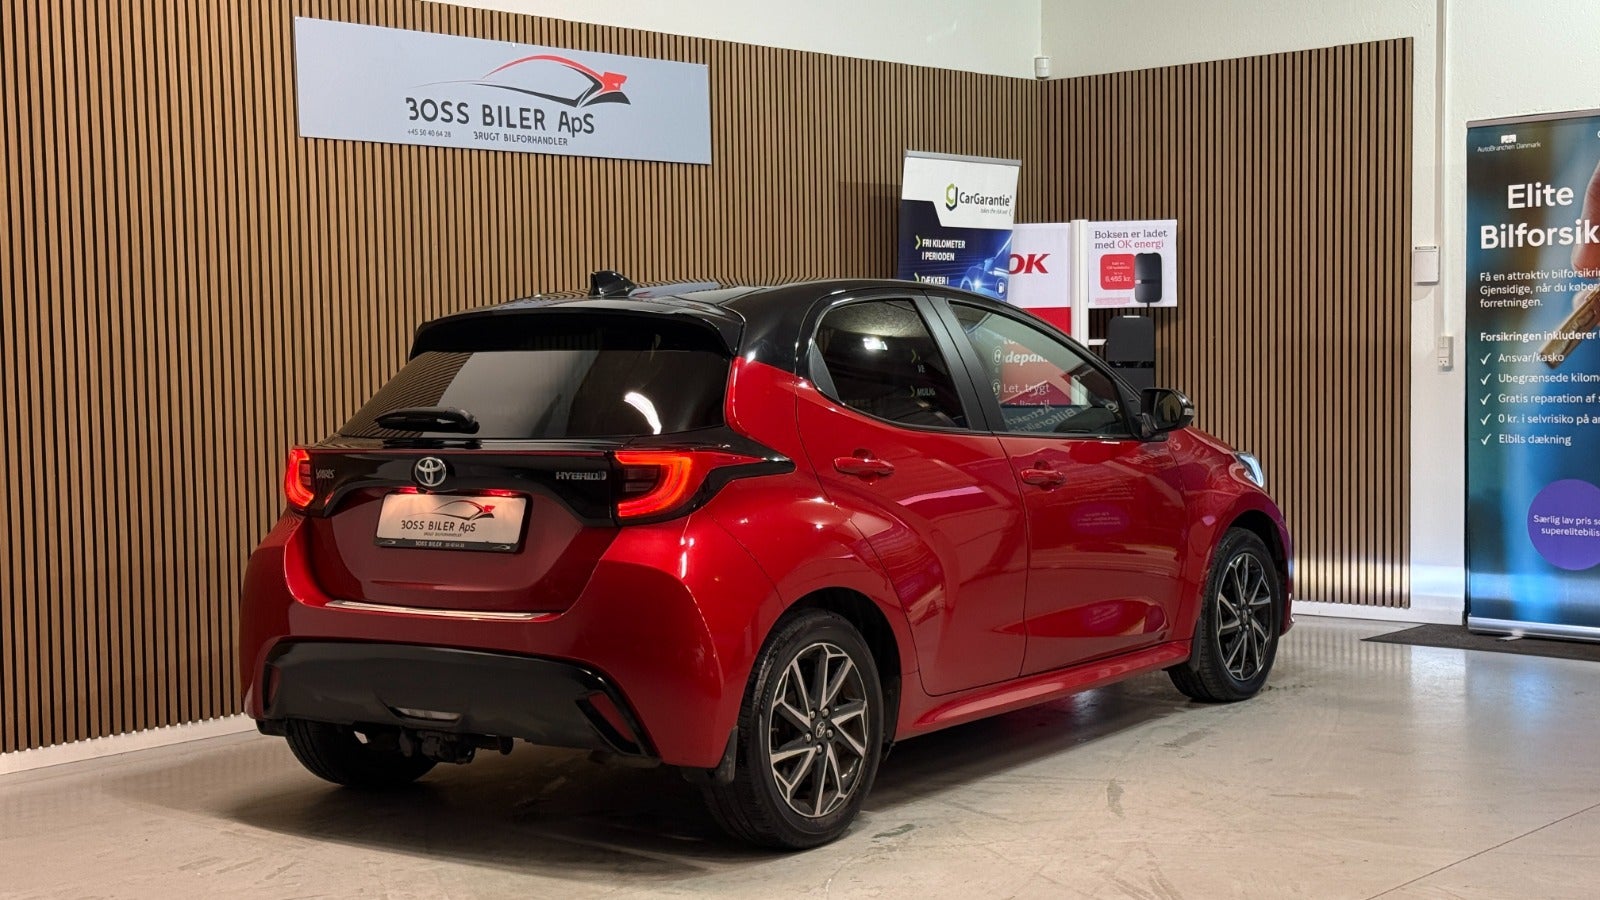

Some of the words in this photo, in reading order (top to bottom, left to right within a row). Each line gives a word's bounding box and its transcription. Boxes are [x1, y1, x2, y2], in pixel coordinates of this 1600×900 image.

[482, 104, 546, 131] BILER
[558, 111, 595, 138] ApS
[503, 133, 568, 146] BILFORHANDLER
[1507, 182, 1574, 209] Elite
[1094, 230, 1129, 239] Boksen
[1143, 229, 1168, 238] ladet
[922, 239, 931, 248] FRI
[932, 239, 966, 249] KILOMETER
[1094, 241, 1115, 249] med
[1117, 240, 1133, 249] OK
[1134, 240, 1164, 250] energi
[925, 252, 955, 261] PERIODEN
[1008, 253, 1050, 275] OK
[1480, 272, 1491, 282] Få
[1493, 273, 1505, 281] en
[1506, 271, 1549, 281] attraktiv
[1480, 284, 1533, 297] Gjensidige,
[1536, 284, 1552, 293] når
[1554, 283, 1566, 292] du
[1568, 282, 1596, 292] køber
[1480, 298, 1543, 309] forretningen.
[1480, 332, 1541, 343] Forsikringen
[1543, 330, 1597, 340] inkluderer
[1498, 352, 1565, 363] Ansvar/kasko
[1498, 373, 1568, 385] Ubegrænsede
[1498, 393, 1528, 404] Gratis
[1530, 393, 1583, 405] reparation
[1585, 393, 1596, 403] af
[1498, 413, 1505, 424] 0
[1507, 413, 1520, 424] kr.
[1521, 413, 1525, 424] i
[1527, 413, 1574, 424] selvrisiko
[1576, 413, 1589, 426] på
[1498, 434, 1526, 444] Elbils
[1528, 434, 1572, 447] dækning
[1533, 514, 1560, 526] Særlig
[1562, 516, 1574, 525] lav
[1576, 517, 1592, 526] pris
[428, 522, 455, 532] BILER
[459, 522, 477, 533] ApS
